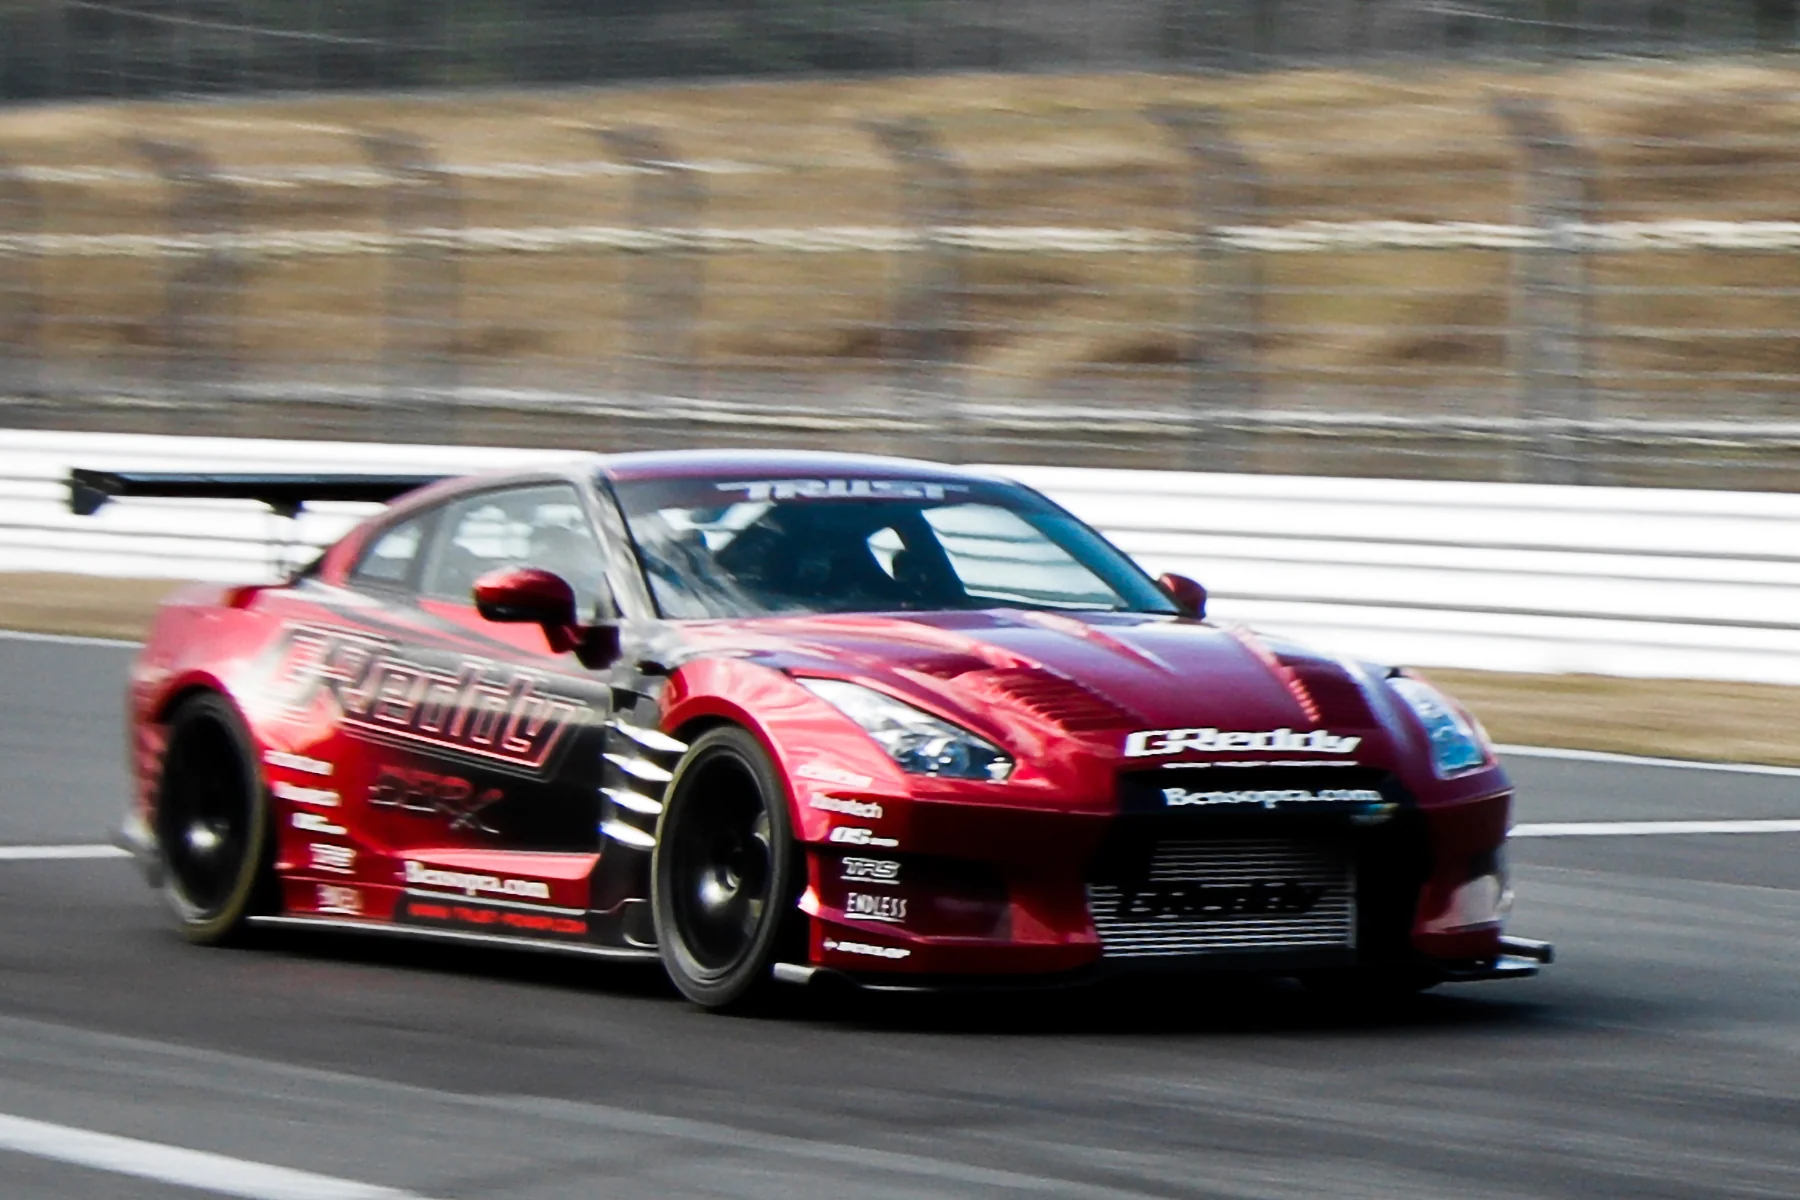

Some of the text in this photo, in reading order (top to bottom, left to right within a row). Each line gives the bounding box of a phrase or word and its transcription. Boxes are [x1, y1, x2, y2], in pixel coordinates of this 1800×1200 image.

[714, 479, 969, 500] TRUST
[1124, 727, 1362, 757] GReddy
[845, 892, 908, 919] ENDLESS
